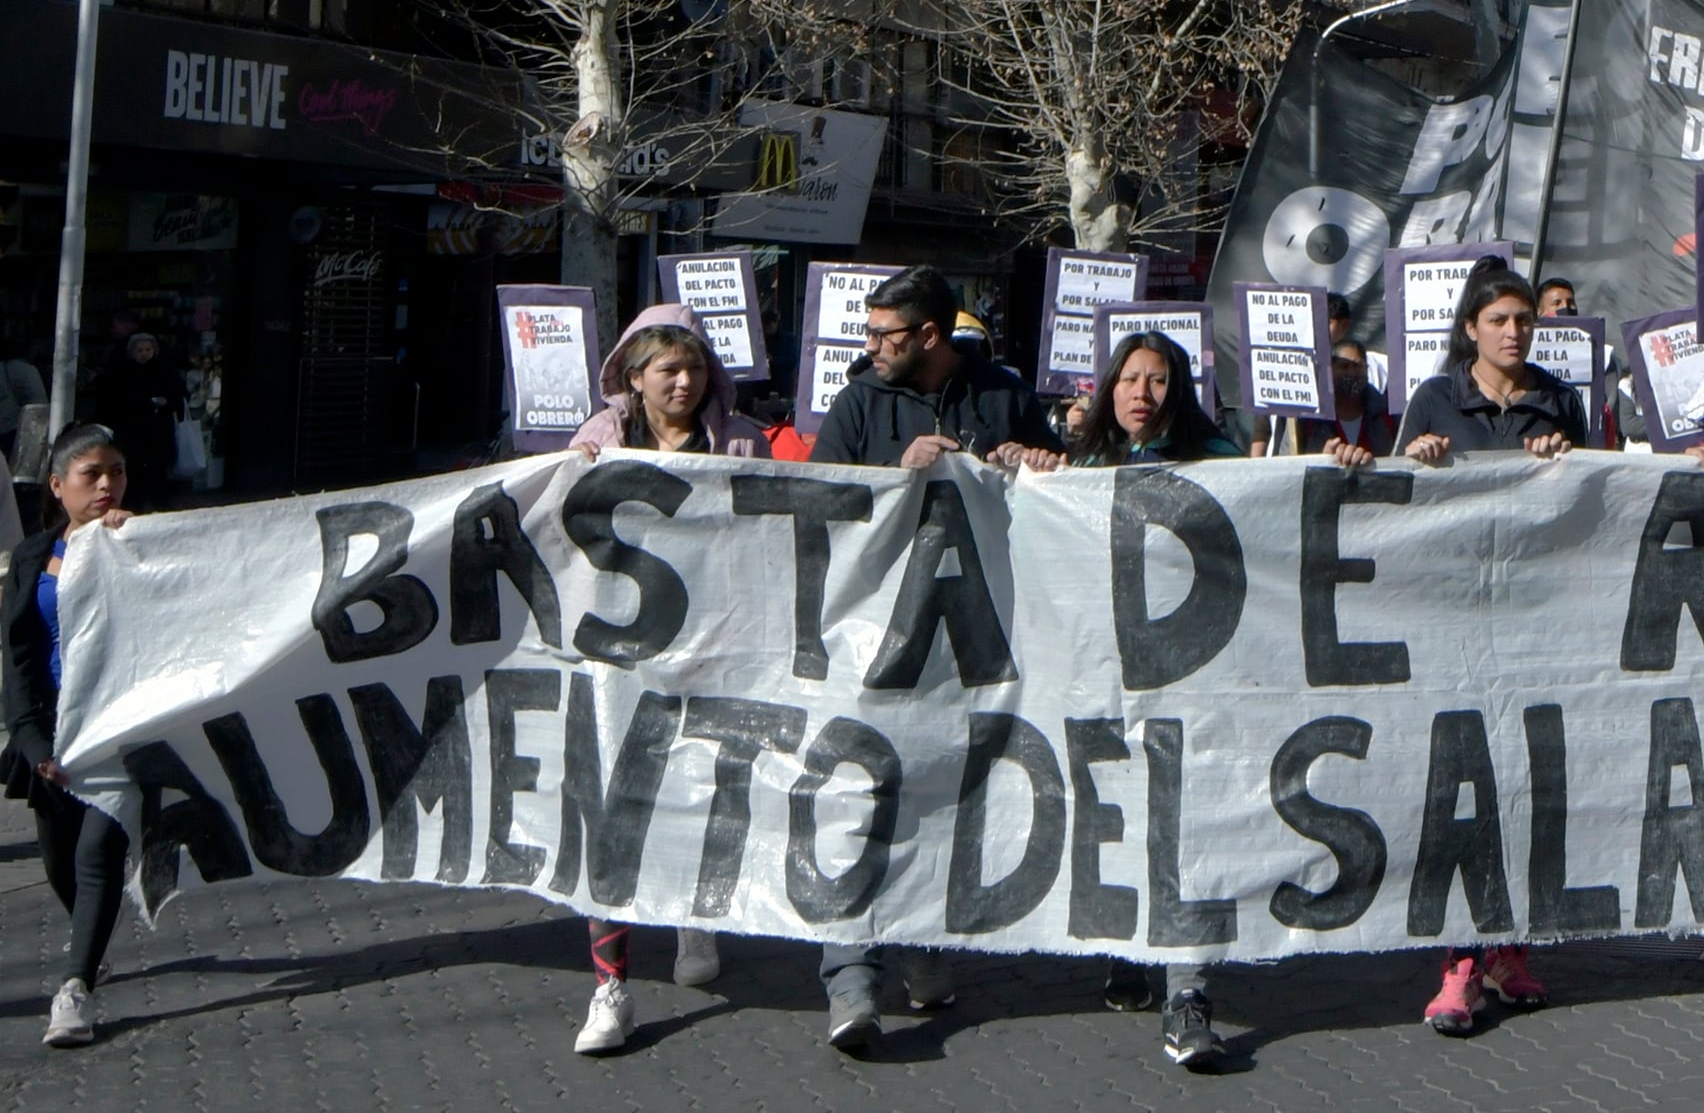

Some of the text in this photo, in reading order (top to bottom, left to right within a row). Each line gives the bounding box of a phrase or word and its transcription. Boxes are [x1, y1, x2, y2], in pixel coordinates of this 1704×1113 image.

[164, 49, 289, 130] BELIEVE
[682, 260, 736, 273] ANULACION
[1064, 263, 1132, 279] POR TRABAJO
[1410, 268, 1468, 281] POR TRAB
[685, 278, 736, 291] DEL PACTO
[829, 276, 845, 290] NO
[849, 278, 865, 291] AL
[1094, 282, 1100, 292] Y
[1062, 294, 1082, 306] POR
[1447, 288, 1453, 299] Y
[688, 296, 738, 308] CON EL FMI
[846, 300, 861, 313] DE
[1252, 294, 1308, 307] NO AL PAGO
[528, 314, 556, 324] PLATA
[1268, 313, 1294, 325] DE LA
[1412, 309, 1435, 321] POR
[529, 324, 571, 334] TRABAJO
[717, 318, 743, 329] PAGO
[841, 322, 868, 336] DEU
[1056, 321, 1080, 333] PARO
[1112, 319, 1199, 333] PARO NACIONAL
[532, 334, 573, 346] VIVIENDA
[718, 337, 731, 347] LA
[1267, 331, 1298, 343] DEUDA
[1538, 331, 1551, 343] AL
[1662, 329, 1692, 343] PLATA
[1408, 340, 1437, 351] PARO
[1666, 338, 1697, 352] TRABA
[1053, 352, 1092, 364] PLAN DE
[1256, 352, 1309, 367] ANULACION
[1536, 349, 1568, 362] DE LA
[823, 372, 845, 386] DEL
[1259, 369, 1309, 385] DEL PACTO
[533, 394, 574, 409] POLO
[1260, 387, 1311, 403] CON EL FMI
[313, 460, 1019, 688] BASTA
[1111, 466, 1414, 691] DE
[122, 669, 903, 925] AUMENTO
[944, 712, 1238, 947] DEL
